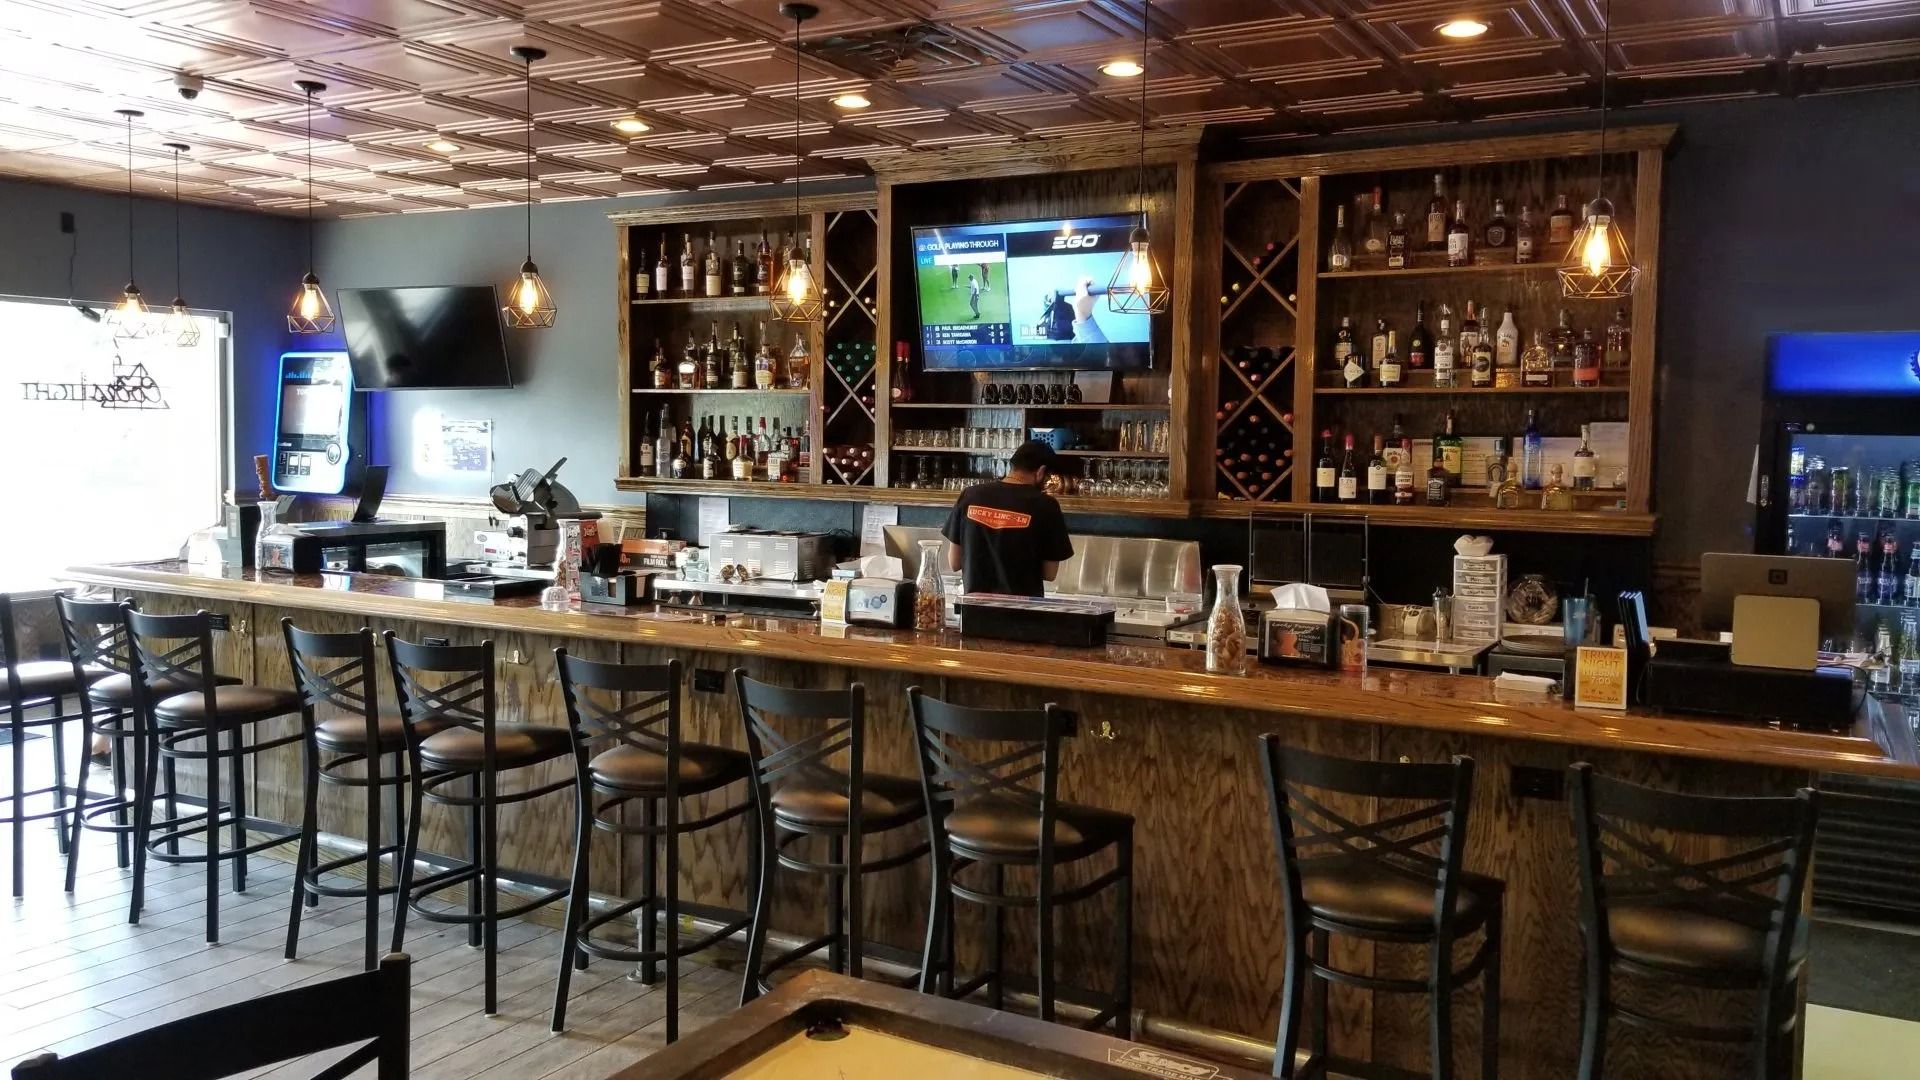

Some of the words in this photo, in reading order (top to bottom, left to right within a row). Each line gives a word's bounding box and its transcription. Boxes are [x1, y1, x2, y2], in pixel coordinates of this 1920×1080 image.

[927, 243, 943, 251] GOLF
[945, 241, 969, 249] PLAYING
[969, 240, 999, 248] THROUGH
[1051, 234, 1098, 249] EGO
[920, 257, 933, 265] LIVE
[969, 509, 993, 518] LUCKY
[643, 557, 655, 566] FILM
[656, 557, 668, 567] ROLL
[1583, 650, 1621, 659] TRIVIA
[1583, 660, 1619, 669] NIGHT
[1147, 1066, 1180, 1077] TRADE
